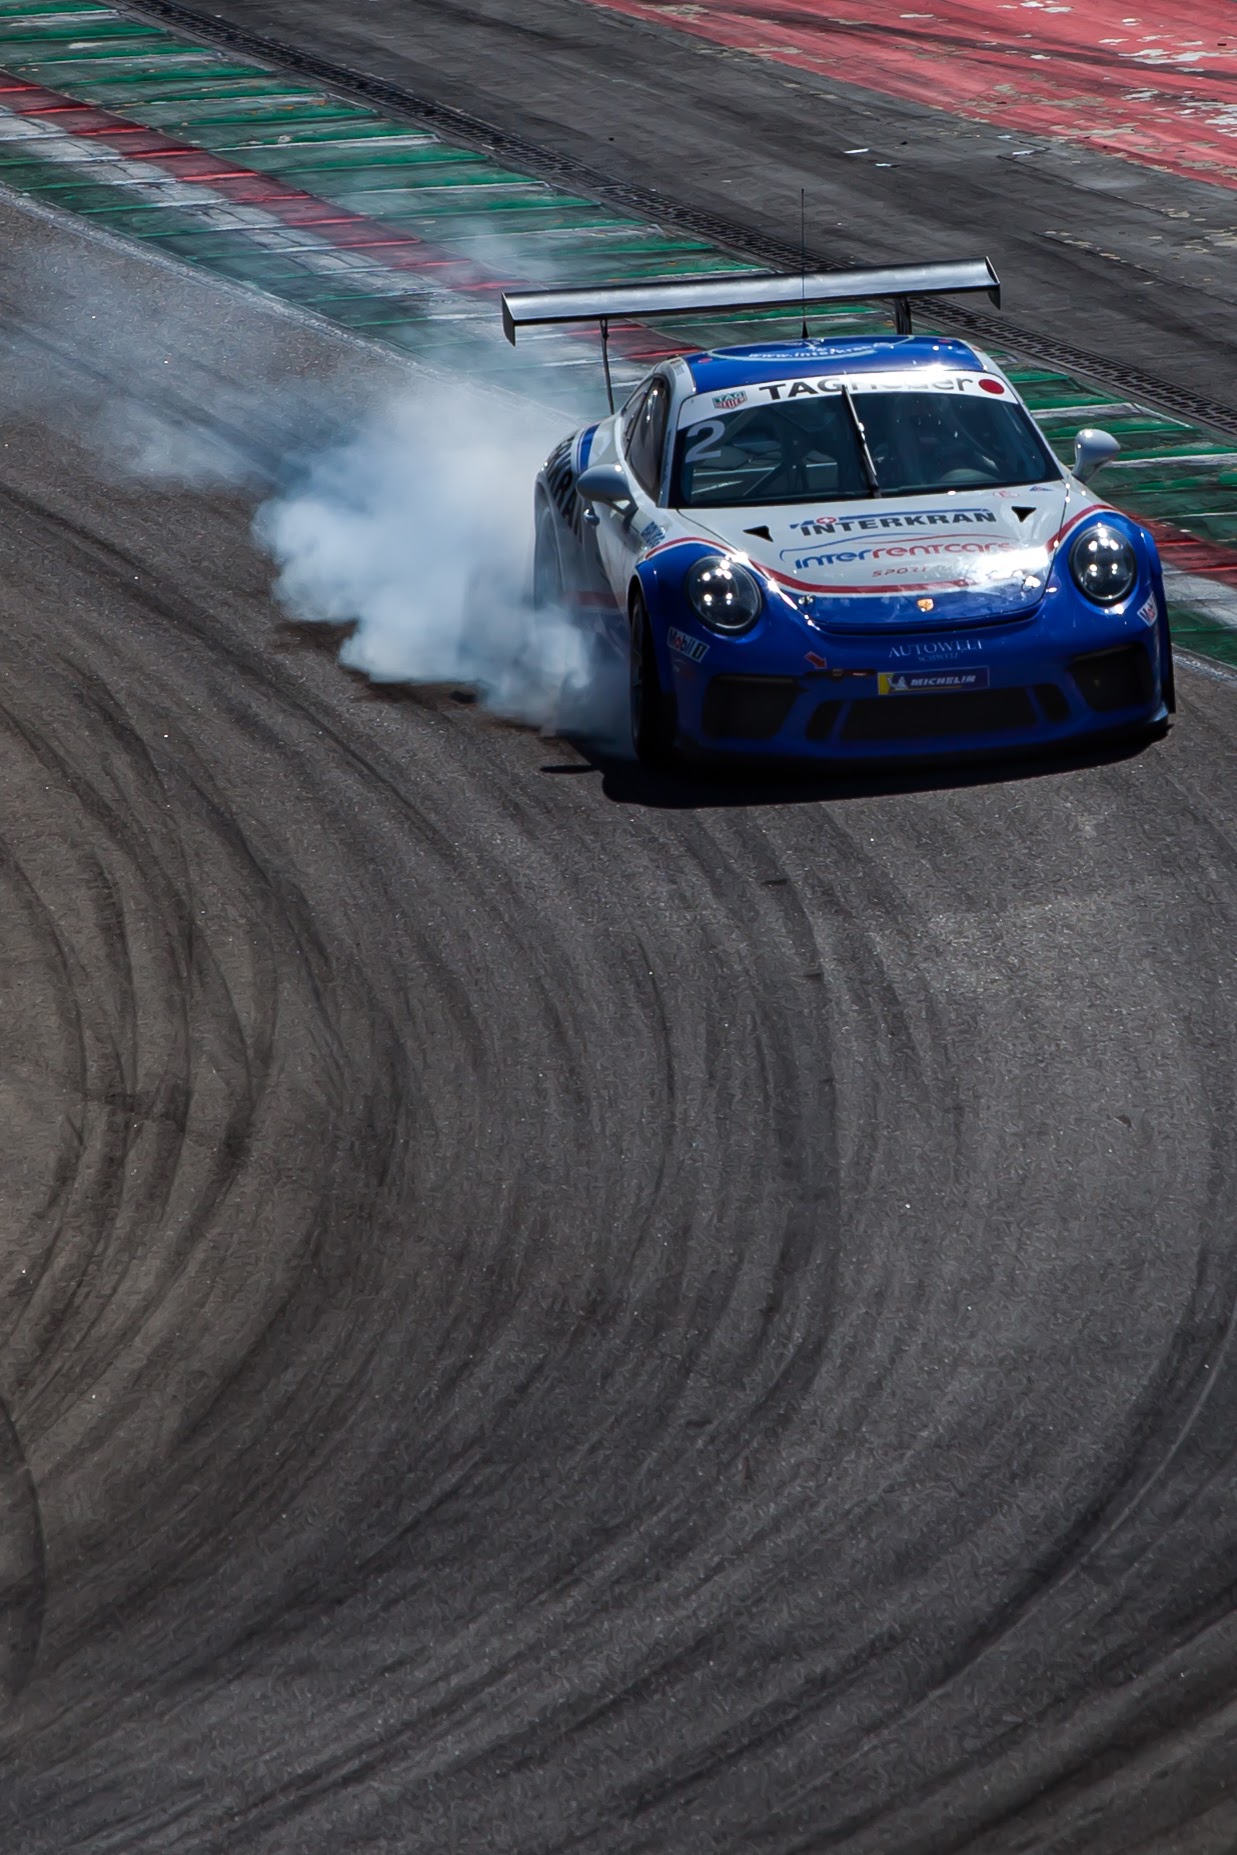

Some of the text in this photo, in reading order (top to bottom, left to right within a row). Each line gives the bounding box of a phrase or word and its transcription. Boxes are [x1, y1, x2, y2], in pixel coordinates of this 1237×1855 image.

[686, 419, 726, 463] 2
[801, 511, 997, 536] INTERKRAN
[669, 629, 697, 655] Mobil
[889, 639, 984, 658] AUTOWELT
[910, 675, 976, 686] MICHELIN
